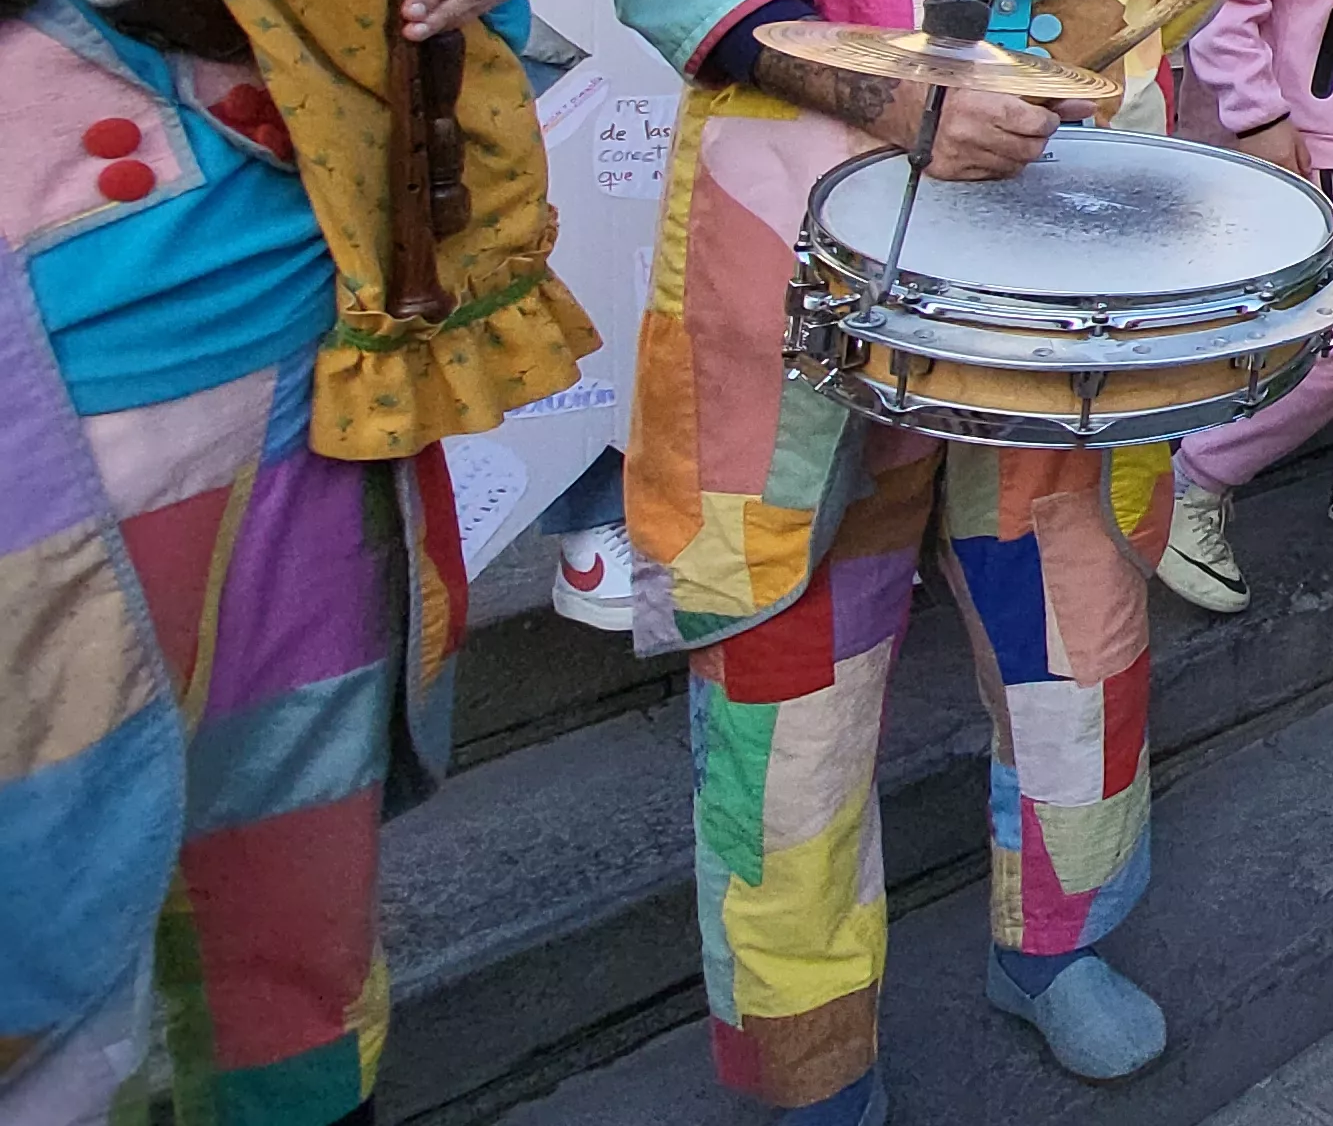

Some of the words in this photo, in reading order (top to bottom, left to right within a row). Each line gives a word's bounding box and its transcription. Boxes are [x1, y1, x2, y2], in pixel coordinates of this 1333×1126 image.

[600, 122, 627, 142] de
[644, 119, 671, 141] las
[598, 170, 634, 191] que
